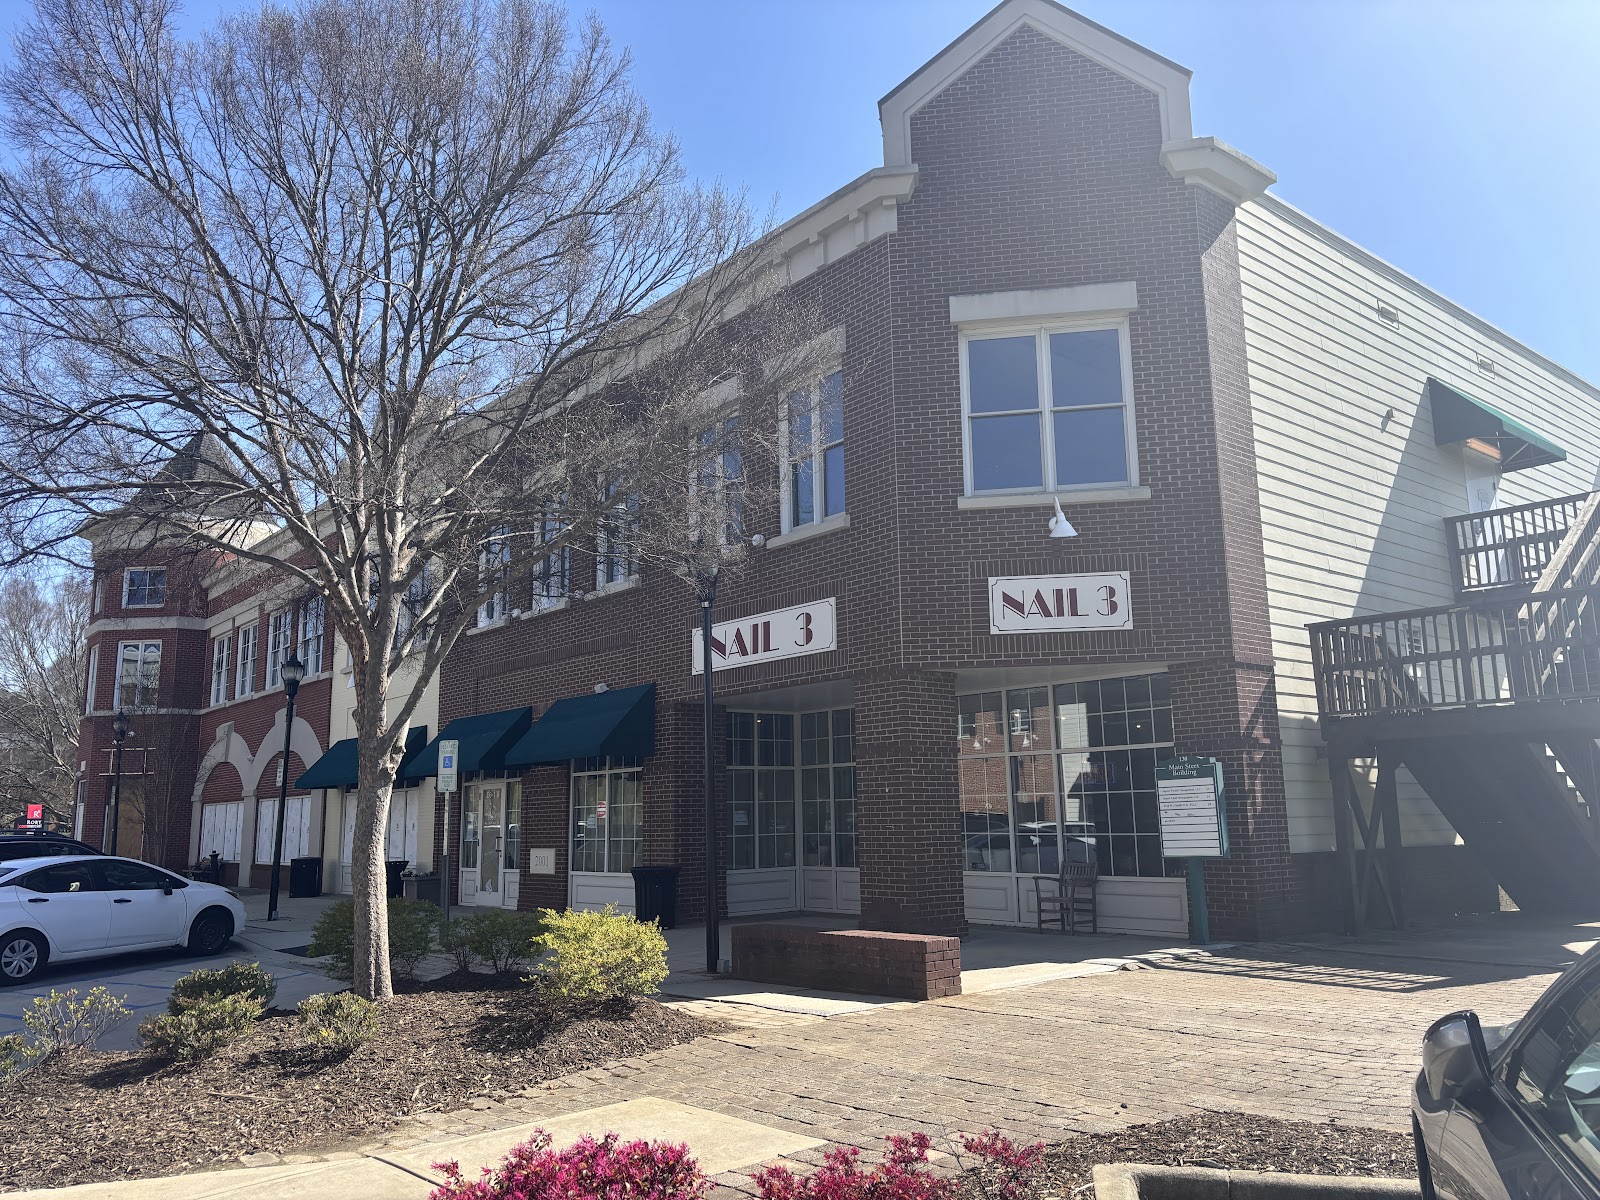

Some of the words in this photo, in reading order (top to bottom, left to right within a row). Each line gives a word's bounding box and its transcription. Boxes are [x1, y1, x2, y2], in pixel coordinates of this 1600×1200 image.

[1002, 588, 1089, 620] NAIL
[1096, 585, 1118, 616] 3
[710, 620, 780, 660] NAIL
[794, 612, 814, 647] 3
[534, 855, 549, 867] 2001
